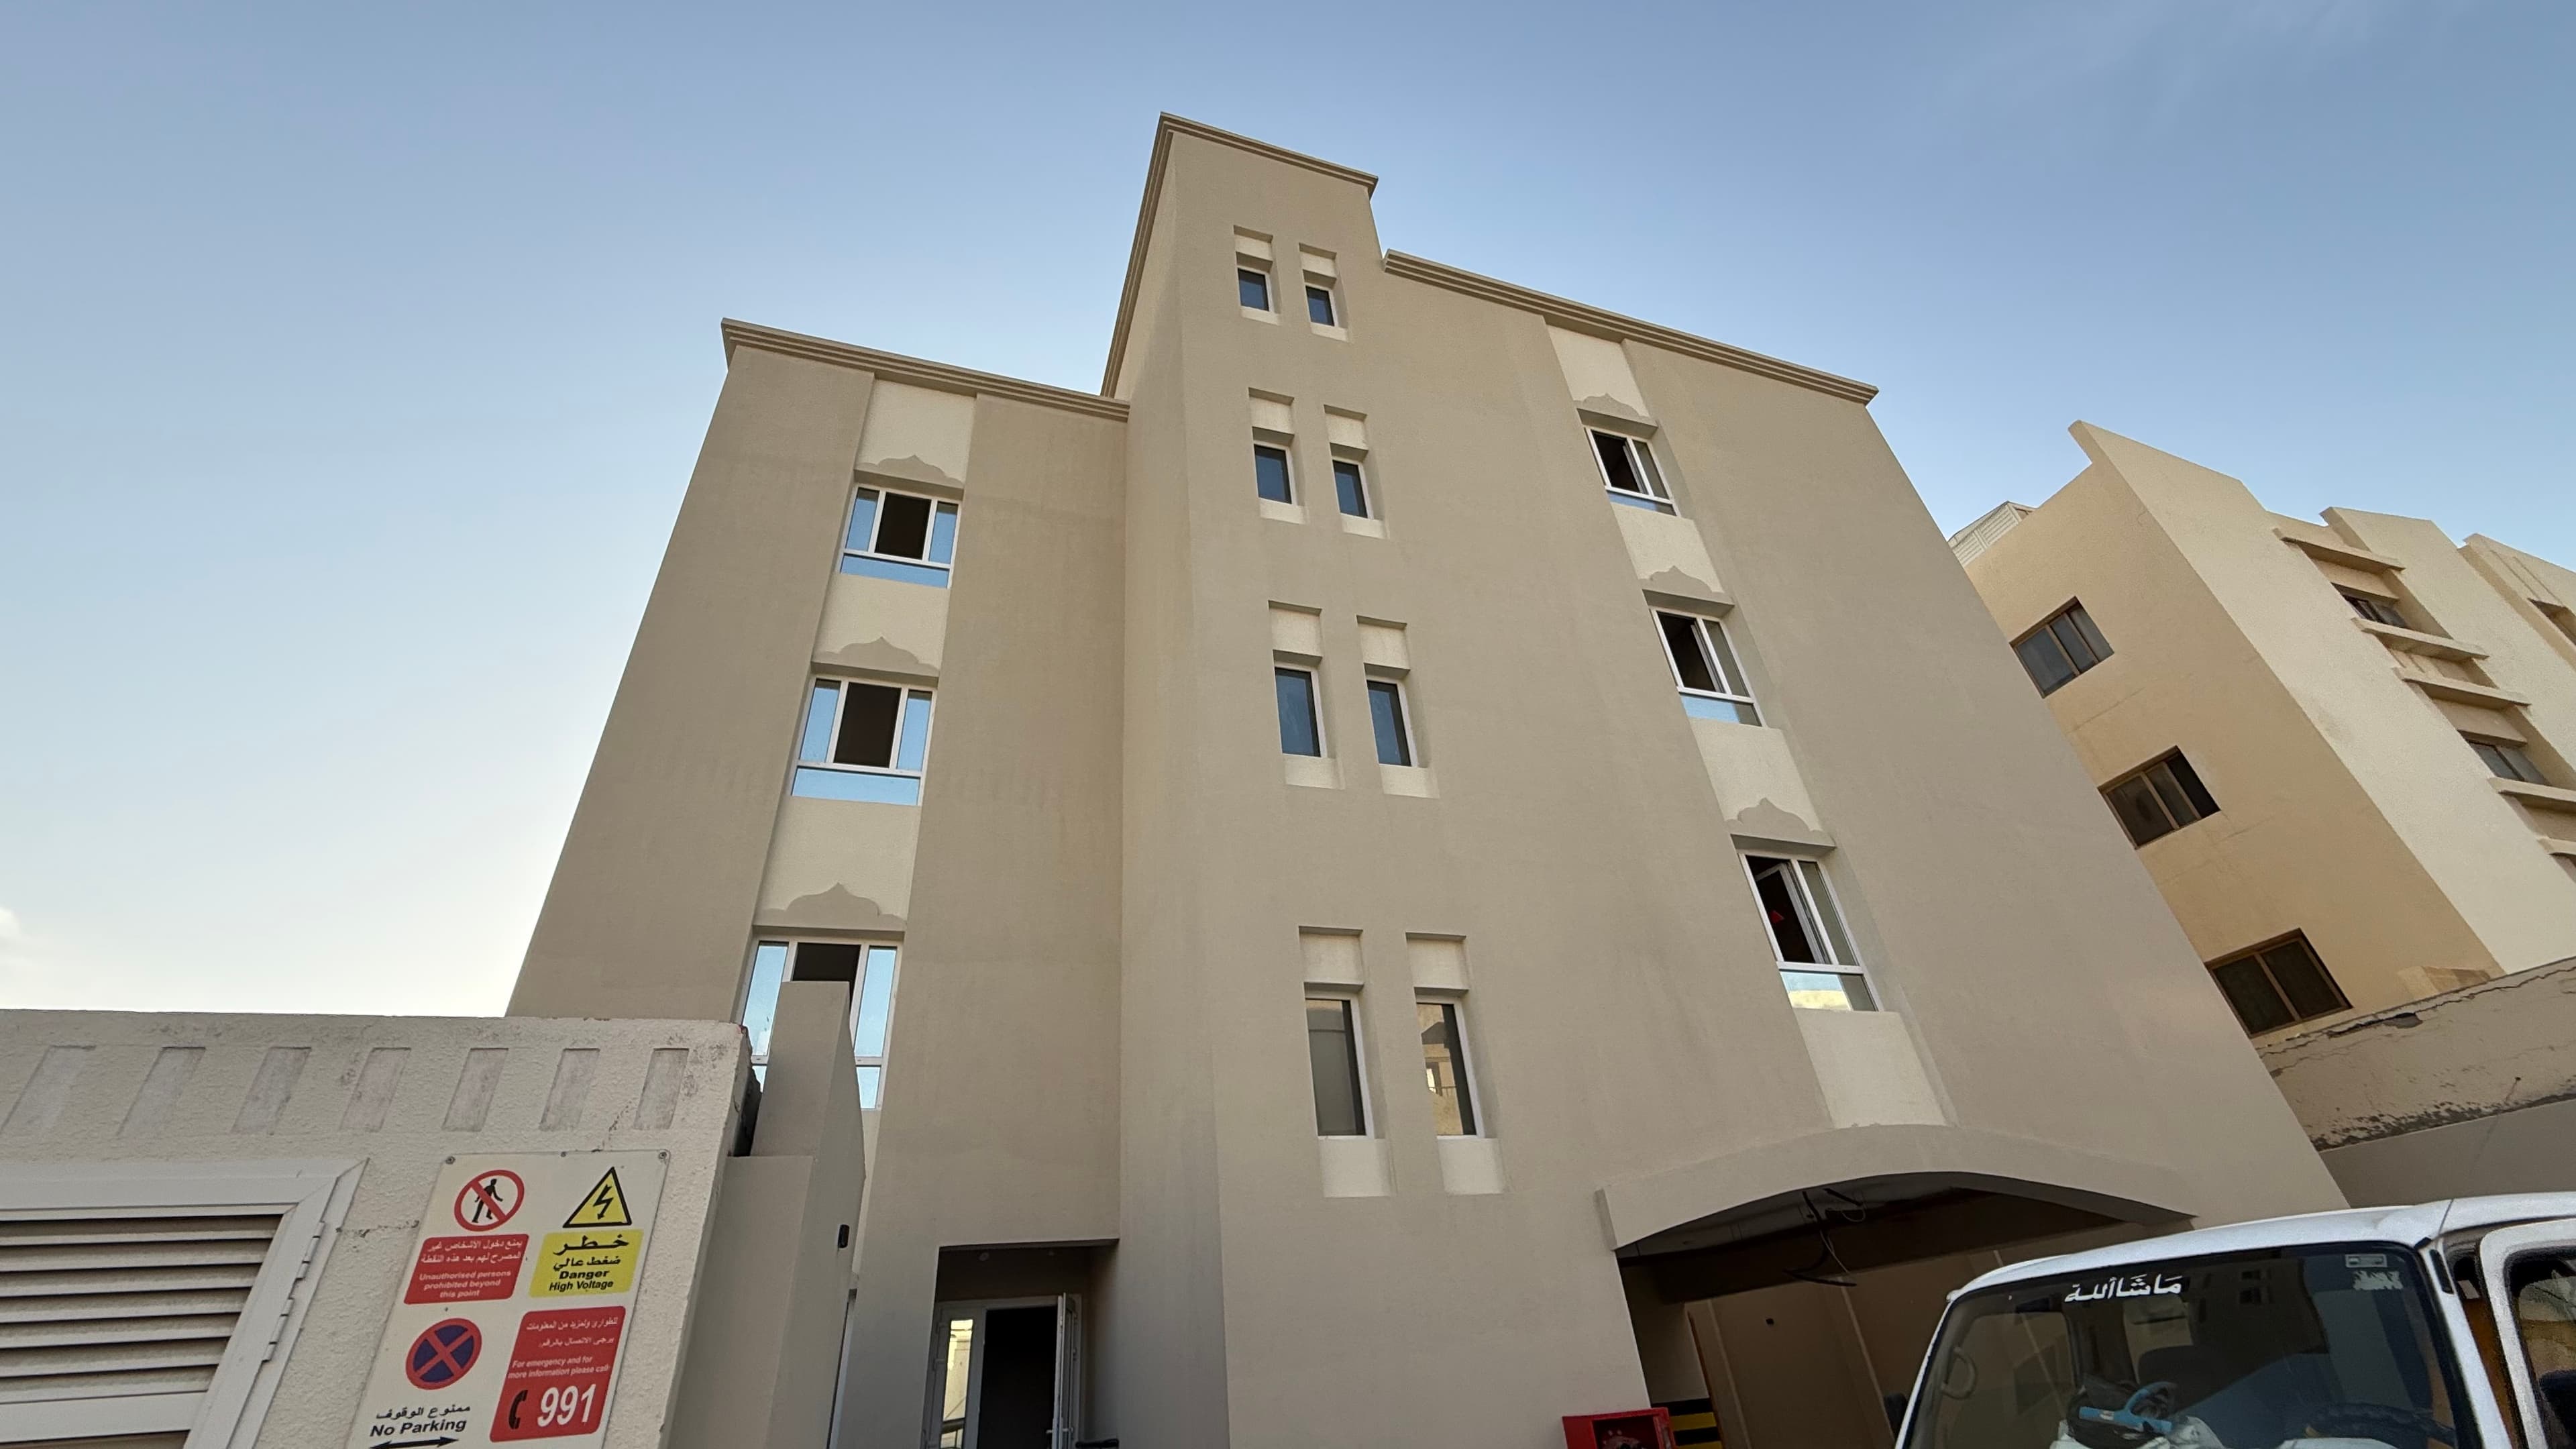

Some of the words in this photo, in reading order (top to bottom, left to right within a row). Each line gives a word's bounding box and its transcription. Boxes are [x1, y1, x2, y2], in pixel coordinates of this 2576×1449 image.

[427, 1242, 443, 1252] غير
[482, 1240, 504, 1250] دخول
[504, 1239, 523, 1250] يمنع
[552, 1234, 629, 1256] خطر
[421, 1253, 444, 1263] النقطة
[446, 1253, 460, 1263] هذه
[463, 1254, 475, 1263] بعد
[476, 1252, 490, 1263] لهم
[490, 1251, 521, 1264] المصرح
[586, 1255, 621, 1266] ضغط
[419, 1271, 476, 1281] Unauthorised
[477, 1270, 511, 1279] persons
[559, 1271, 610, 1280] Danger
[423, 1281, 468, 1291] prohibited
[470, 1279, 501, 1287] beyond
[549, 1282, 574, 1292] High
[576, 1280, 614, 1291] Voltage
[457, 1290, 481, 1299] point
[557, 1322, 569, 1330] من
[512, 1360, 526, 1368] For
[526, 1358, 566, 1368] emergency
[567, 1356, 581, 1364] and
[582, 1355, 594, 1364] for
[508, 1371, 528, 1379] more
[529, 1368, 570, 1379] information
[570, 1365, 595, 1377] please
[537, 1383, 596, 1428] 991
[376, 1406, 425, 1420] الوقوف
[427, 1404, 471, 1419] ممنوع
[370, 1424, 395, 1437] No
[400, 1419, 468, 1435] Parking
